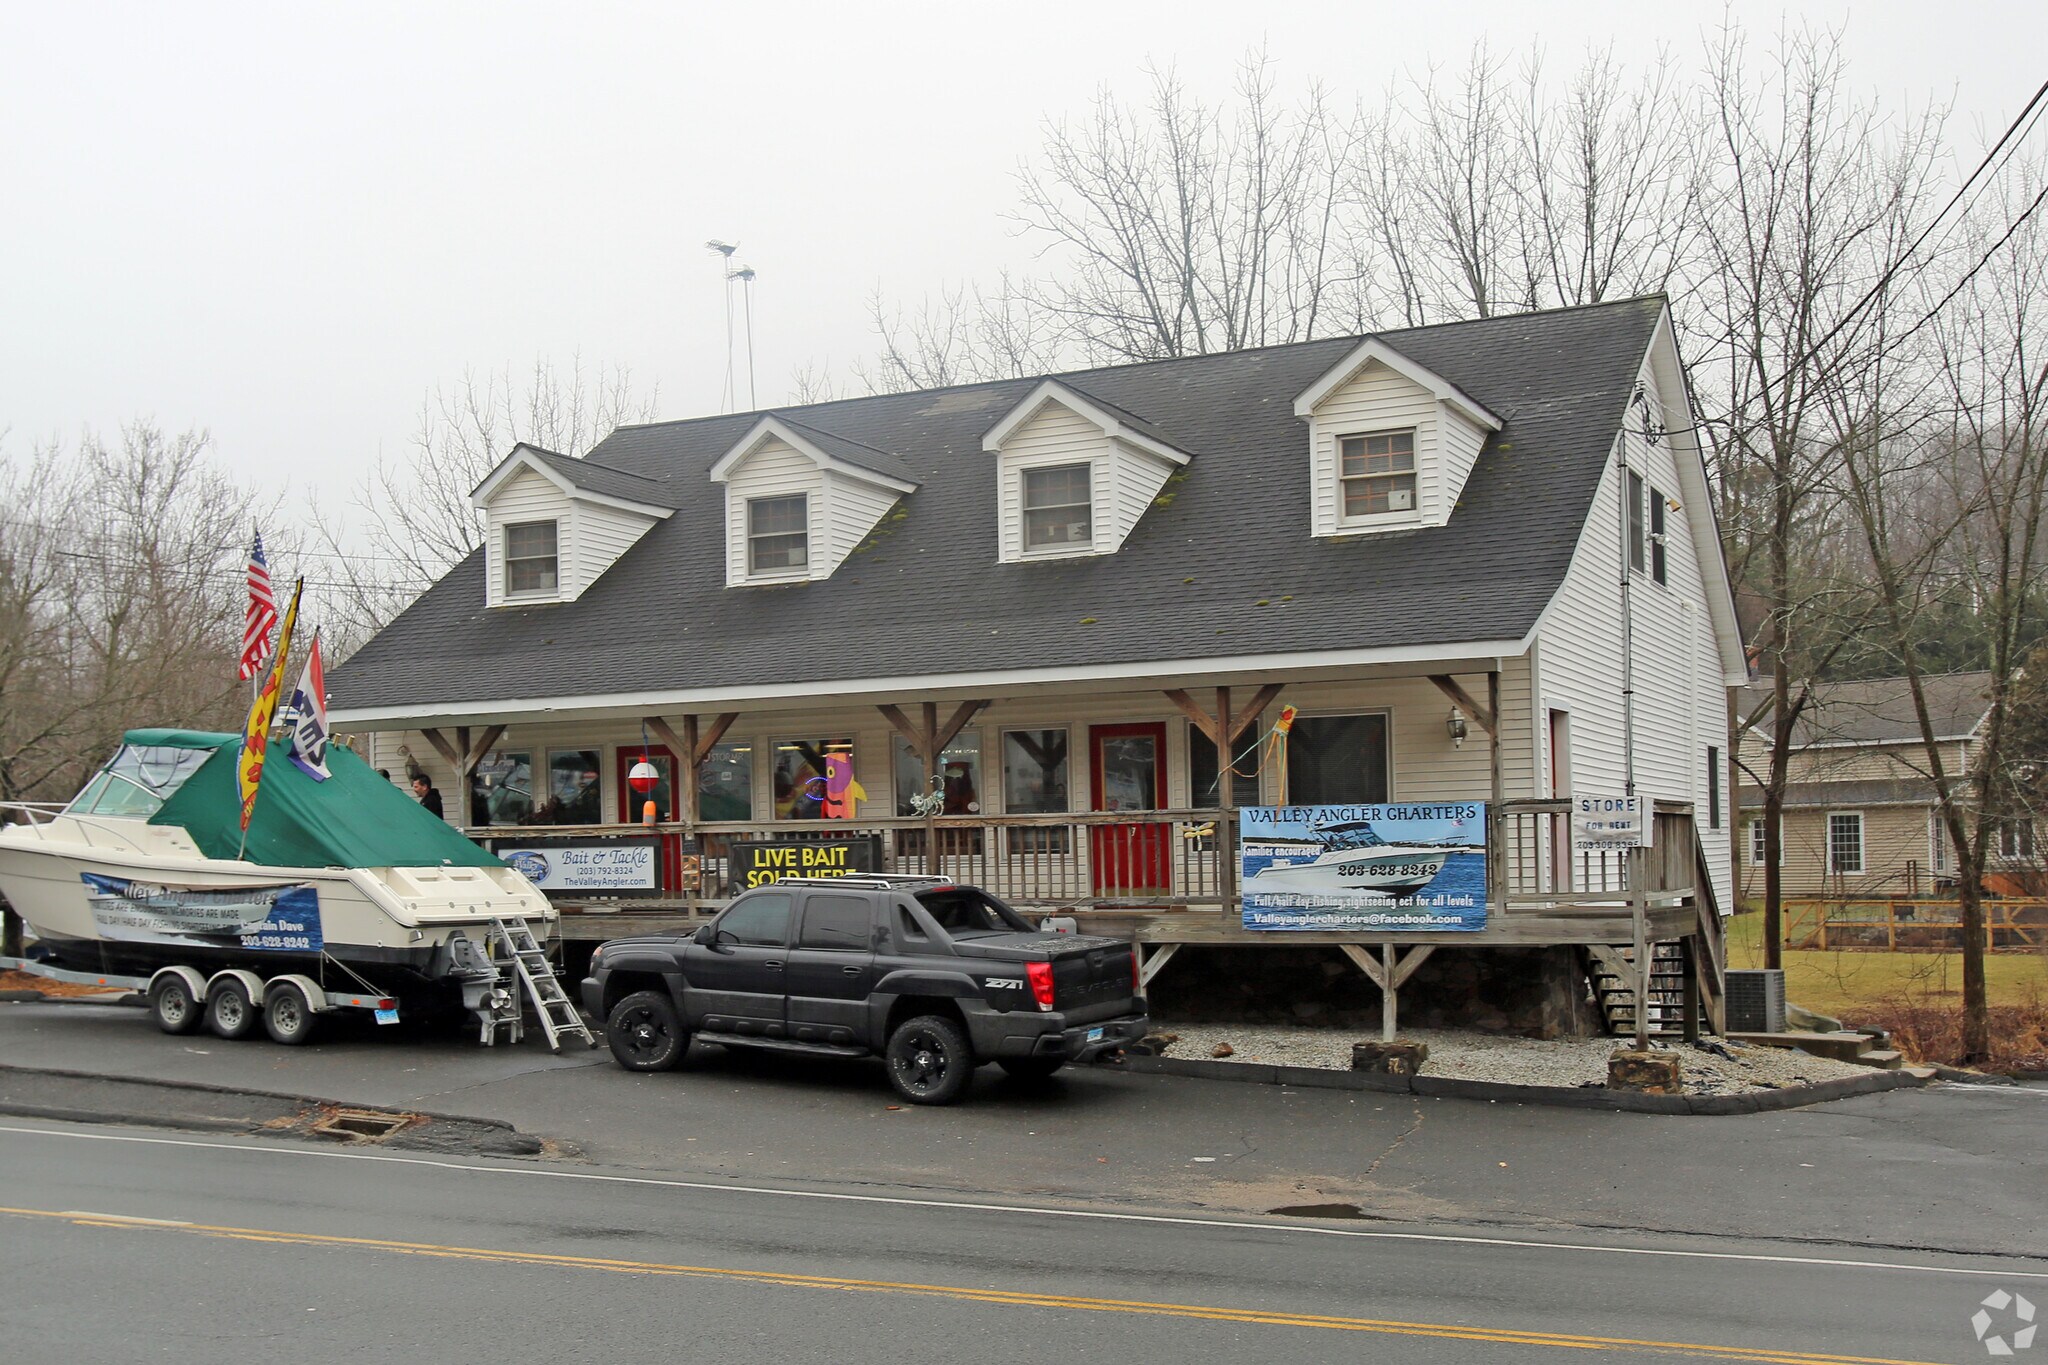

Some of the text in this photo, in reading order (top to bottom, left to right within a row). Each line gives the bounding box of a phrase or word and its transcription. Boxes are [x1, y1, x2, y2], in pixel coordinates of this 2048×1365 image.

[1582, 799, 1635, 812] STORE
[1248, 805, 1476, 823] VALLEY ANGLER CHARTERS
[1586, 821, 1631, 830] FOR RENT
[562, 847, 648, 868] Bait & Tackle
[754, 847, 848, 868] LIVE BAIT
[1274, 846, 1321, 858] encouraged
[576, 866, 633, 876] (203) 792-8324
[1337, 864, 1438, 876] 203-628-8242
[564, 877, 647, 888] TheValleyAngler.com
[1399, 897, 1414, 906] ect
[1416, 895, 1430, 906] for
[1432, 895, 1444, 906] all
[1447, 895, 1474, 906] levels
[205, 908, 218, 918] ARE
[220, 909, 239, 919] MADE
[1254, 913, 1462, 926] Valleyanglercharters@facebook.com
[278, 919, 304, 932] Dave
[240, 935, 310, 949] 203-628-8242
[985, 977, 1024, 990] Z71
